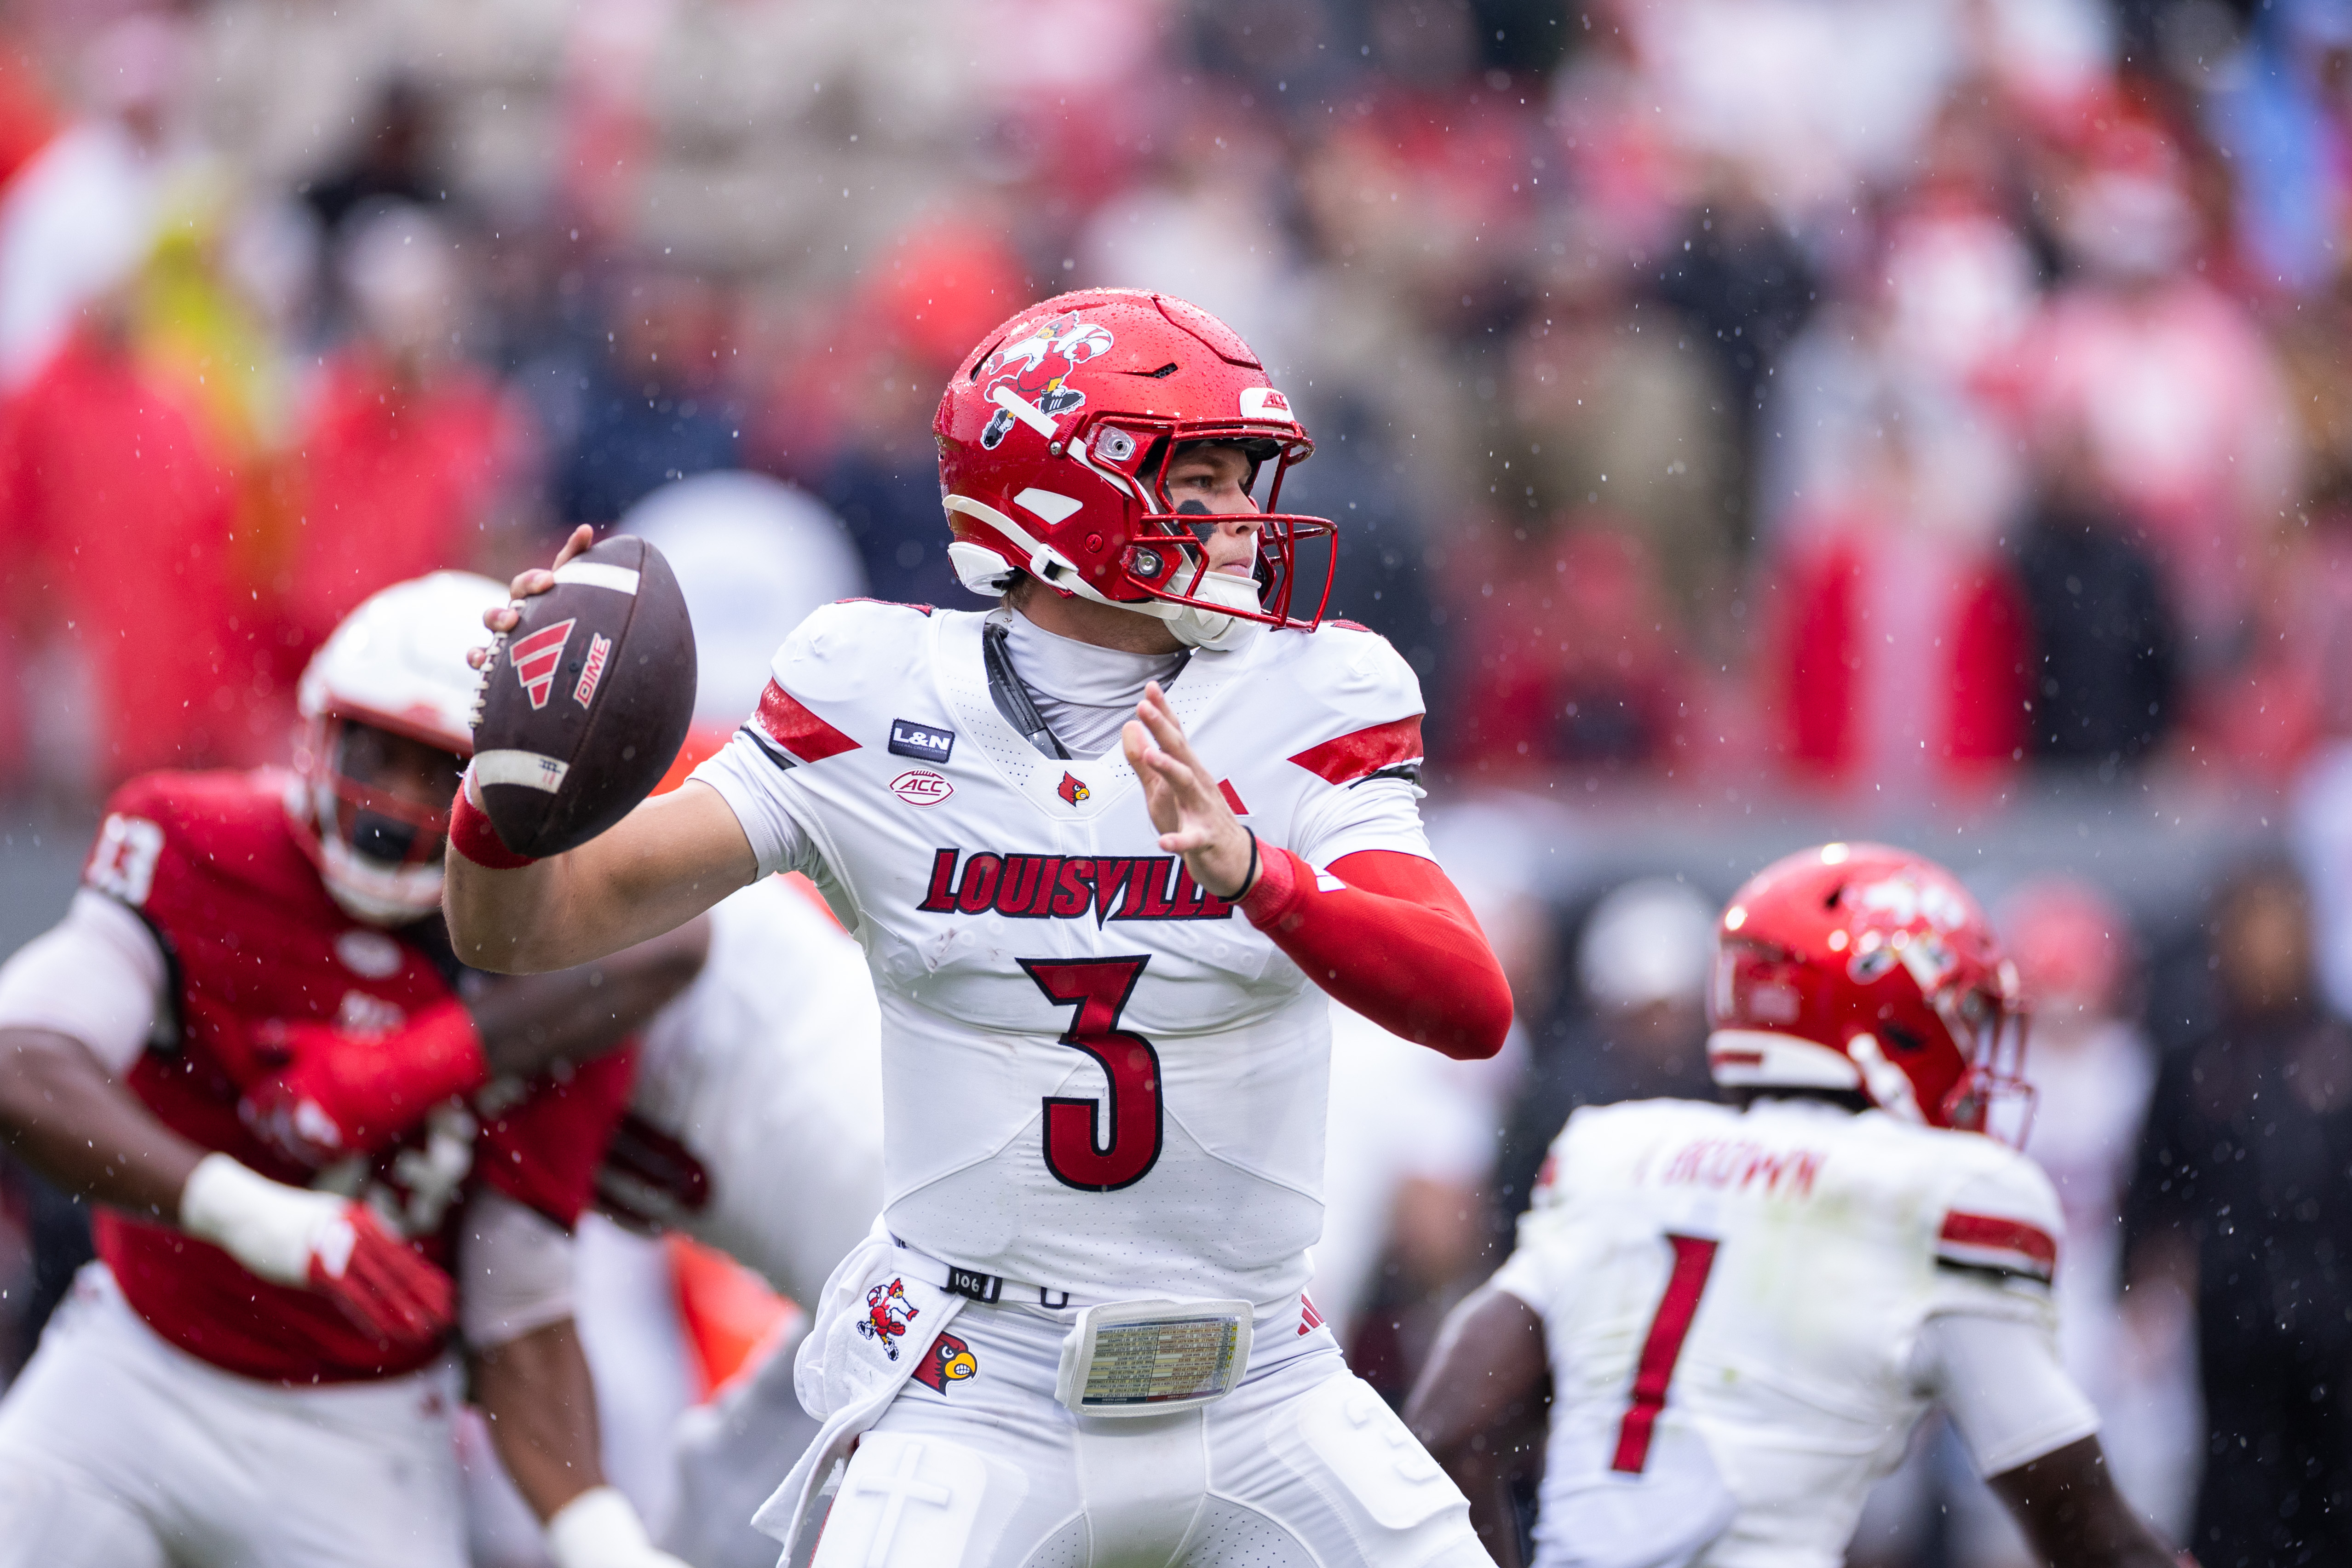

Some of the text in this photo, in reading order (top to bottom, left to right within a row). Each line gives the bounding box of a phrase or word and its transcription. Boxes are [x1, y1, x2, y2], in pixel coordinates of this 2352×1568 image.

[574, 633, 611, 708] DIME
[893, 727, 950, 751] L&N
[899, 779, 946, 793] ACC
[1014, 953, 1163, 1192] 3
[956, 1273, 980, 1292] 106
[1611, 1233, 1721, 1474] 1
